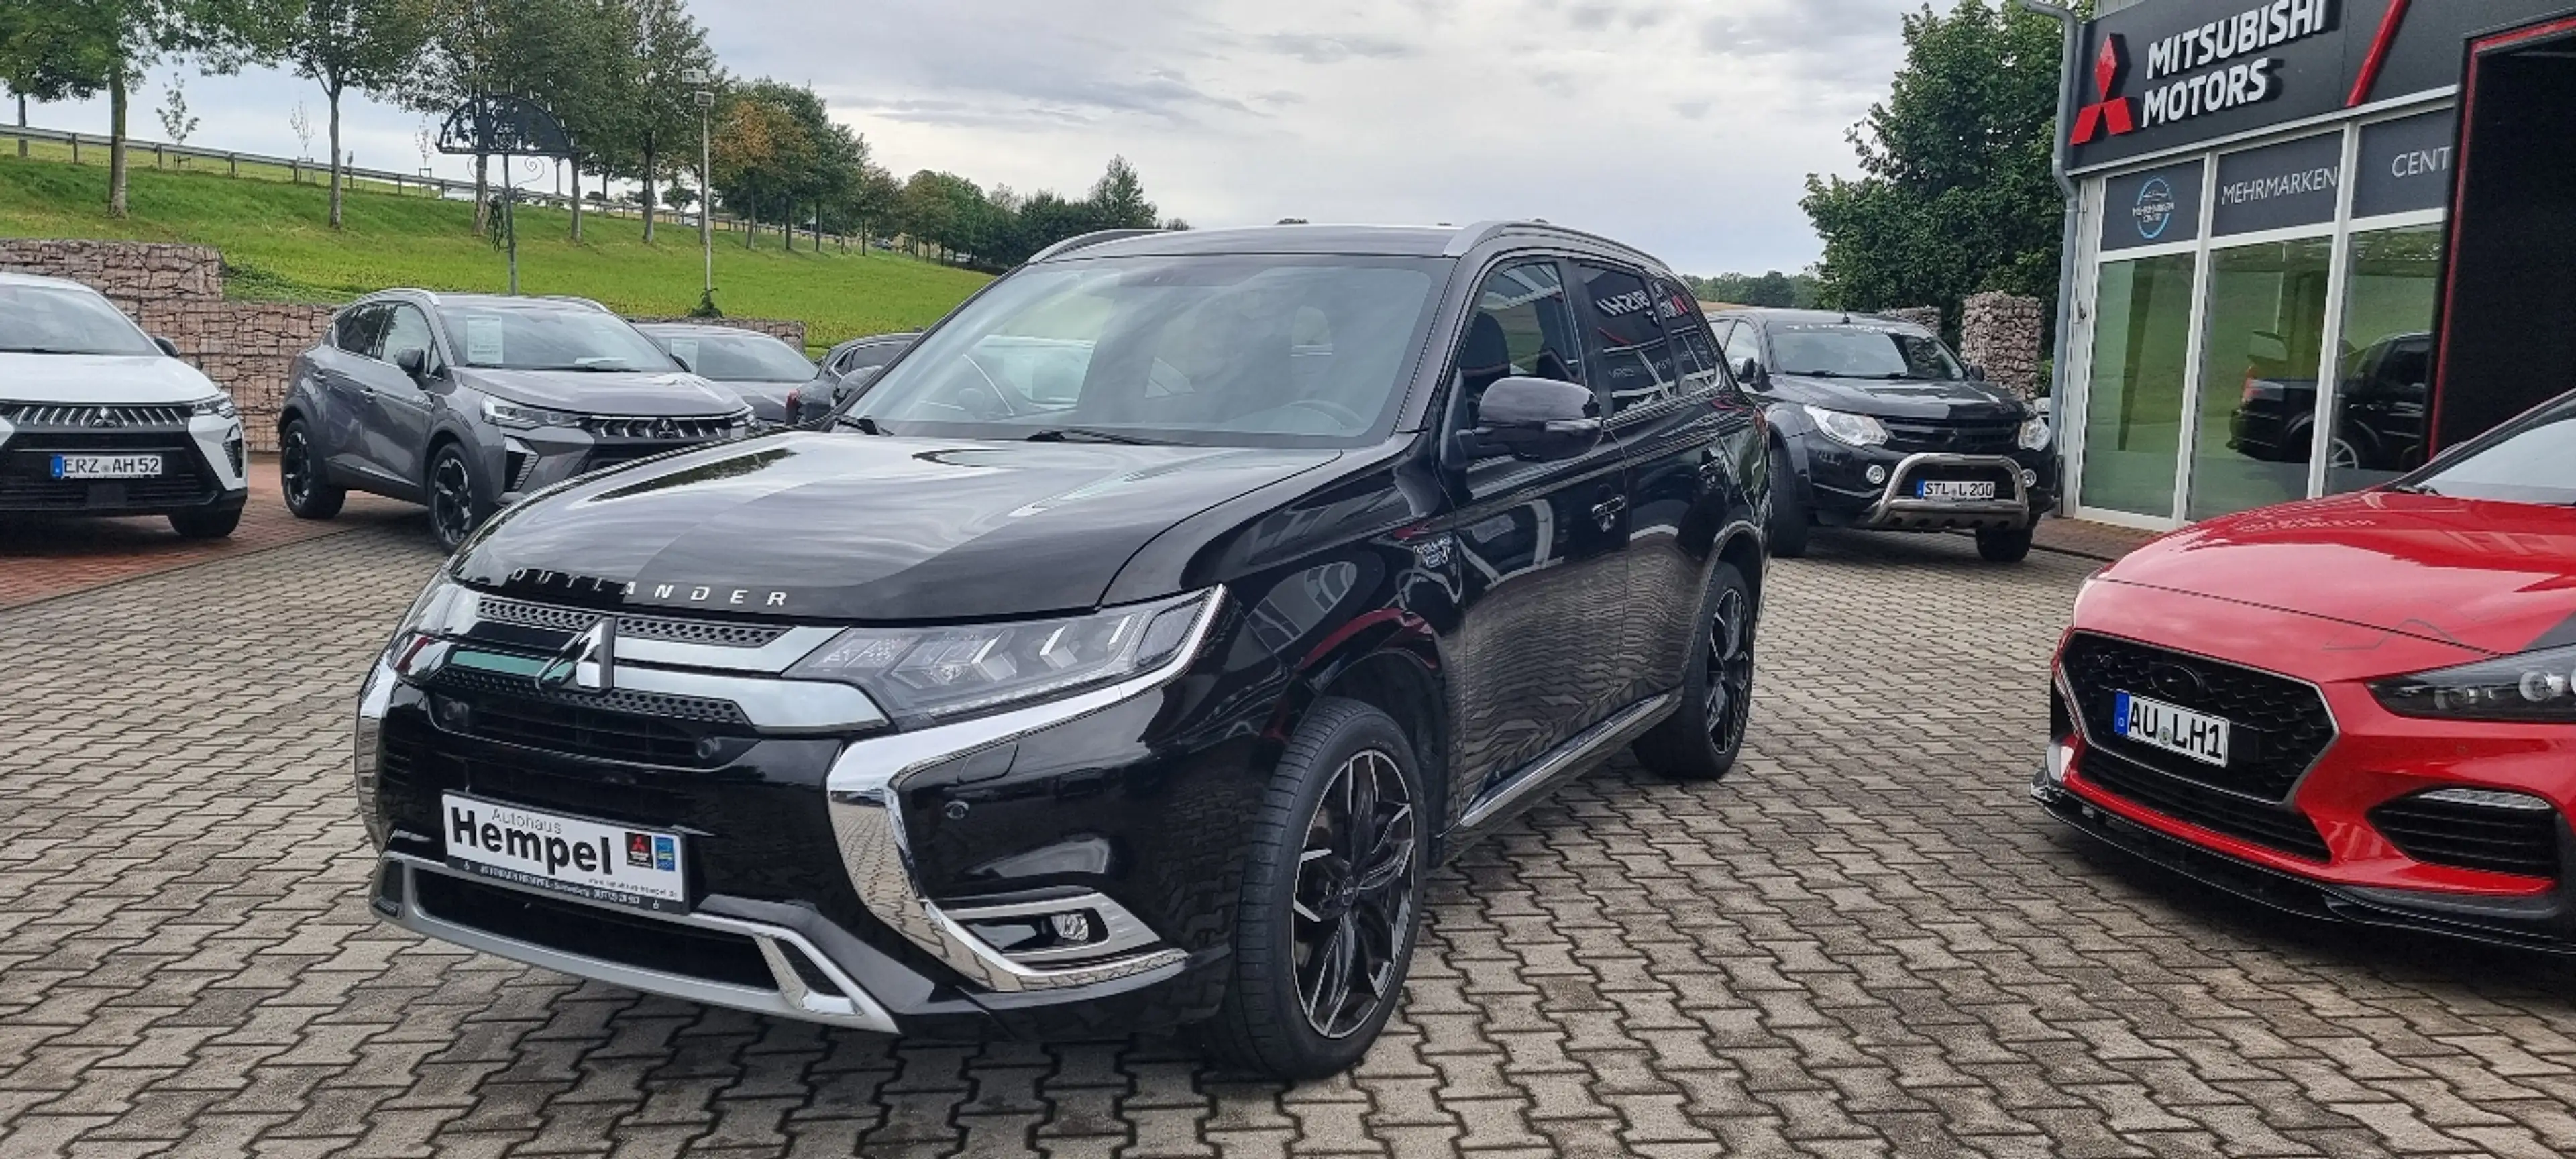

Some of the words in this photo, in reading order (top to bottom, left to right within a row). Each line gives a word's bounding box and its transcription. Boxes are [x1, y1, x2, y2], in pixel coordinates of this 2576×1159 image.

[2147, 0, 2324, 80] MITSUBISHI
[2141, 57, 2269, 128] MOTORS
[2222, 166, 2338, 205] MEHRMARKEN
[64, 458, 99, 474] ERZ
[112, 458, 134, 473] AH
[138, 458, 159, 473] 52
[1925, 483, 1949, 495] STL
[1970, 483, 1992, 496] 200
[511, 567, 787, 606] OUTLANDER
[2129, 701, 2158, 739] AU
[451, 806, 613, 875] Hempel
[492, 808, 562, 834] Autohaus
